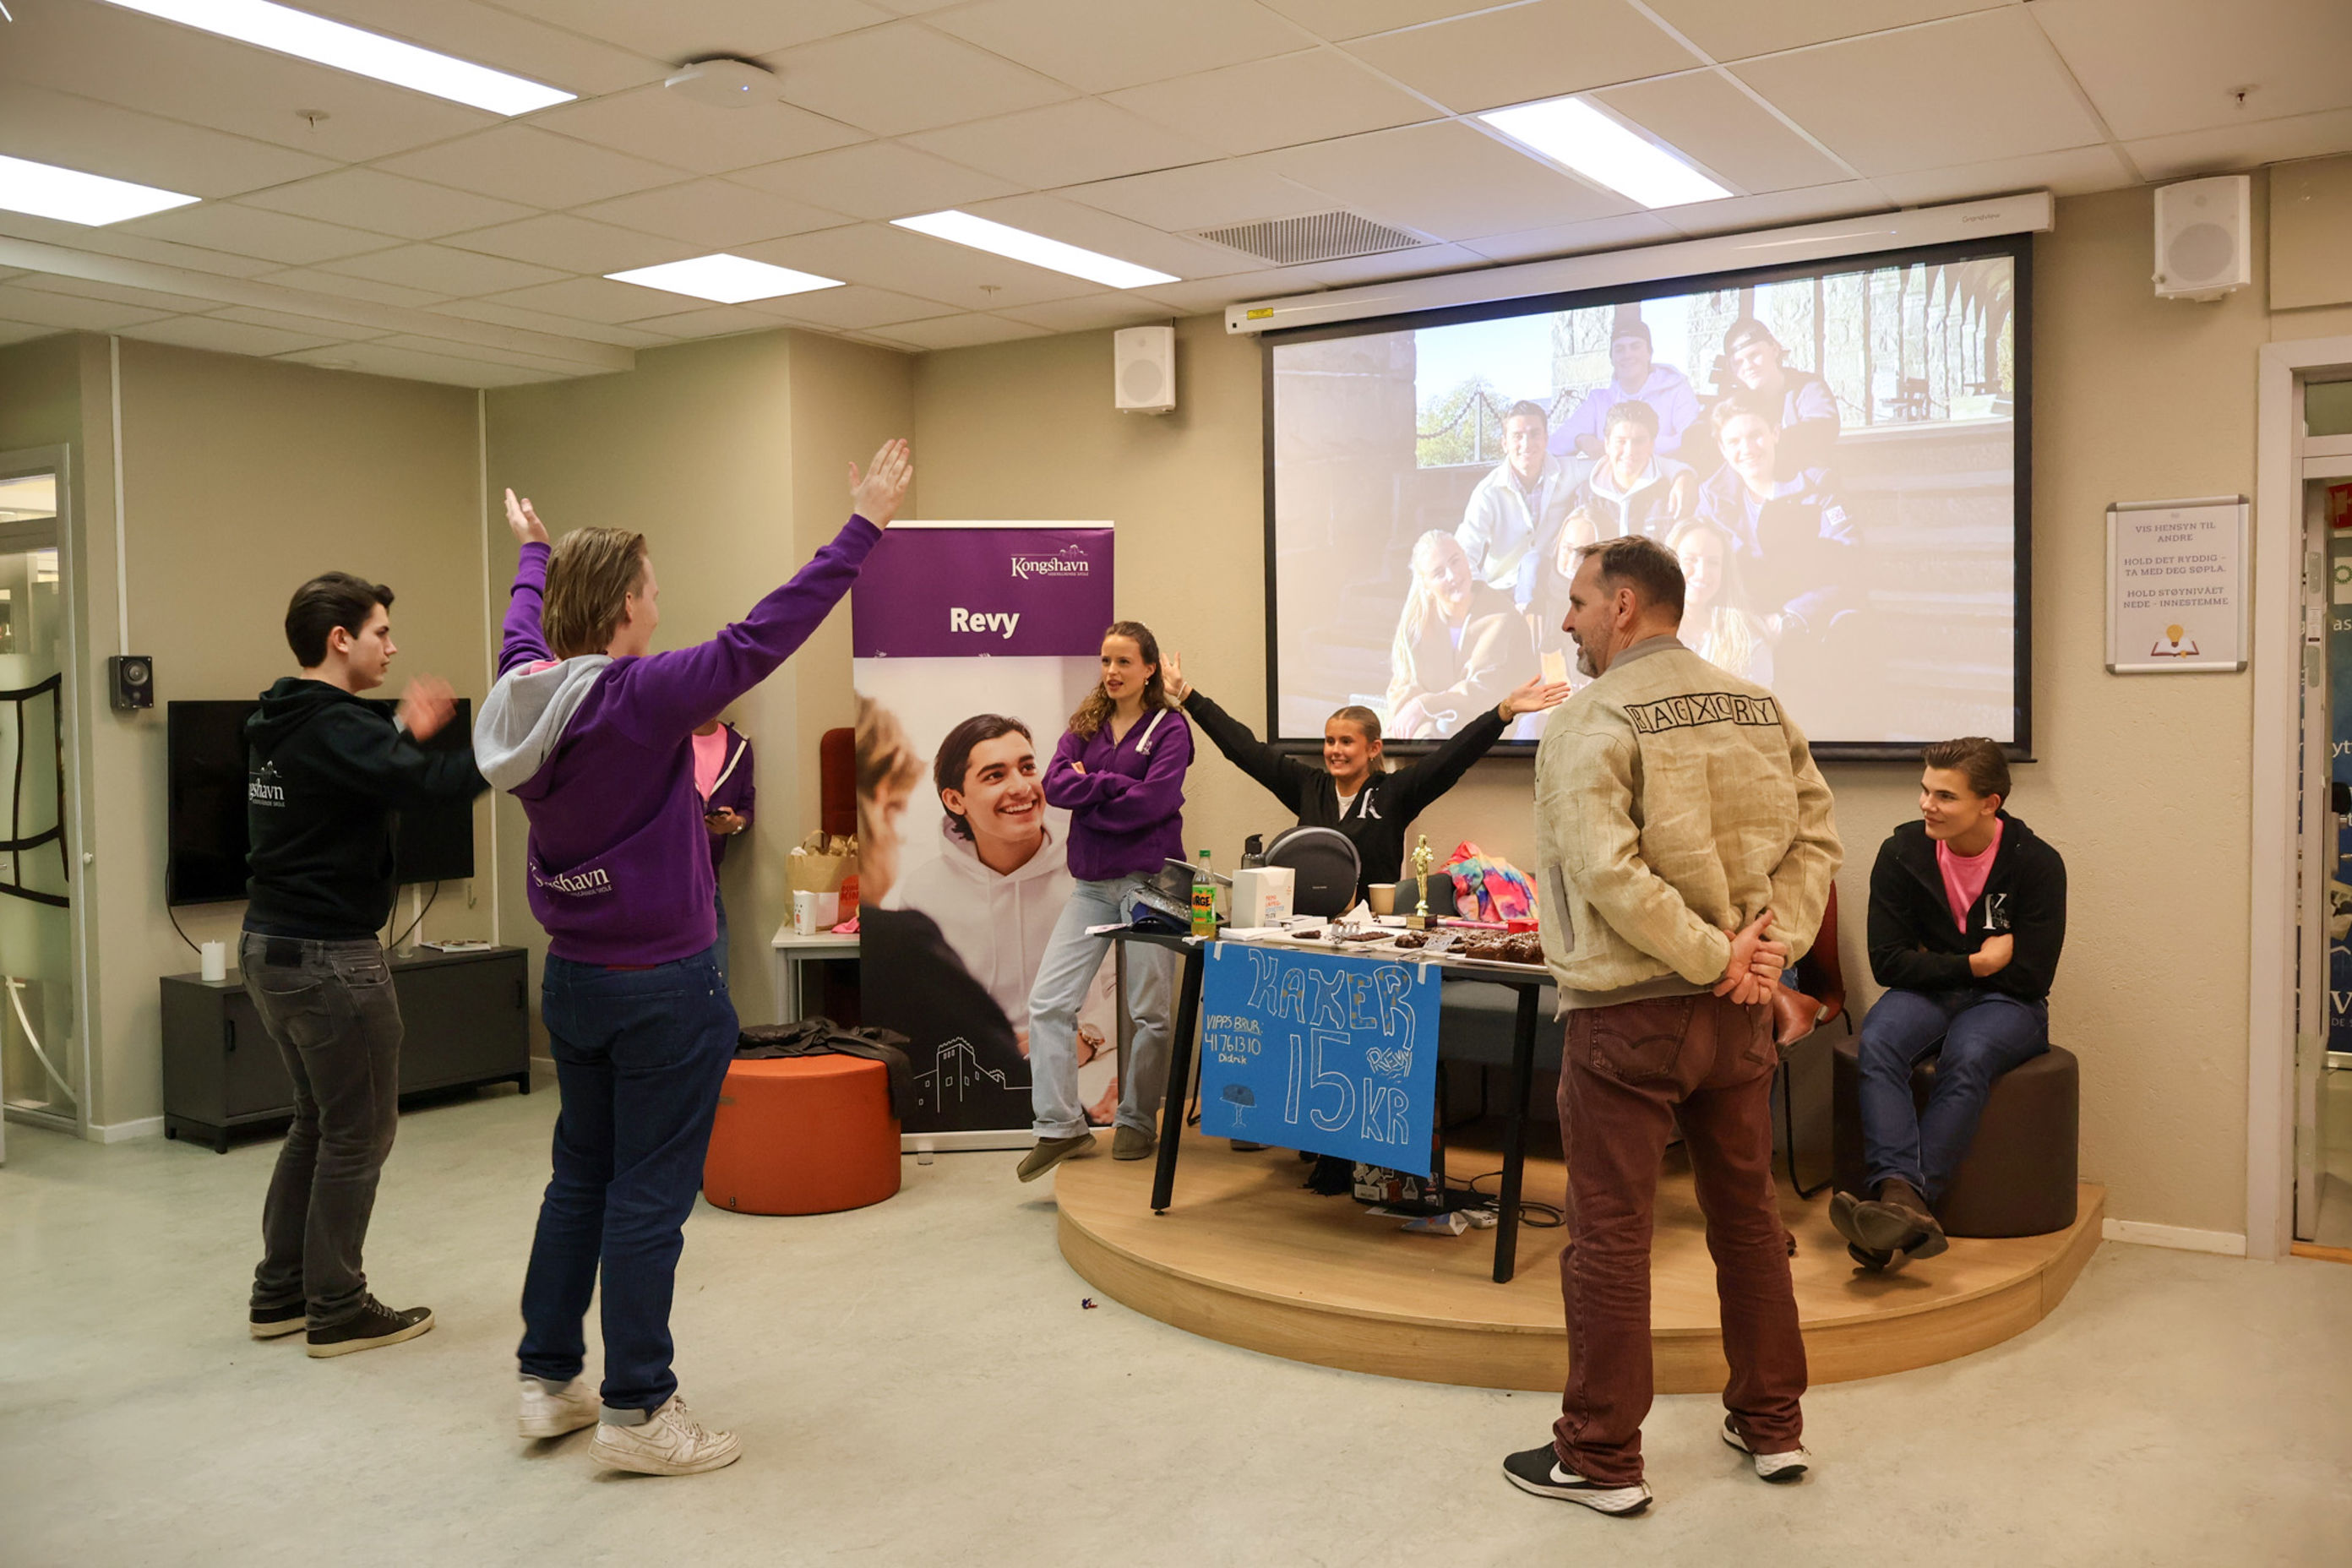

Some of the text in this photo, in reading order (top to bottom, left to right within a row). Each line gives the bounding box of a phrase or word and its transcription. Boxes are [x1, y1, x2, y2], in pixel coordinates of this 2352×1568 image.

[2136, 521, 2216, 533] VIS HENSYN TIL
[2157, 534, 2194, 542] ANDRE
[2124, 558, 2153, 566] HOLD
[2155, 556, 2175, 564] DET
[2177, 554, 2218, 564] RYDDIG
[1010, 557, 1089, 580] Kongshavn
[2125, 565, 2226, 577] TA MED DEG SØPLA.
[2127, 590, 2156, 598] HOLD
[2123, 601, 2150, 609] NEDE
[2159, 597, 2229, 607] INNESTEMME
[950, 607, 1021, 640] Revy
[1628, 694, 1774, 732] BAGXORY
[1206, 1014, 1233, 1030] VIPPS
[1284, 1026, 1356, 1132] 15
[1361, 1076, 1410, 1145] KR
